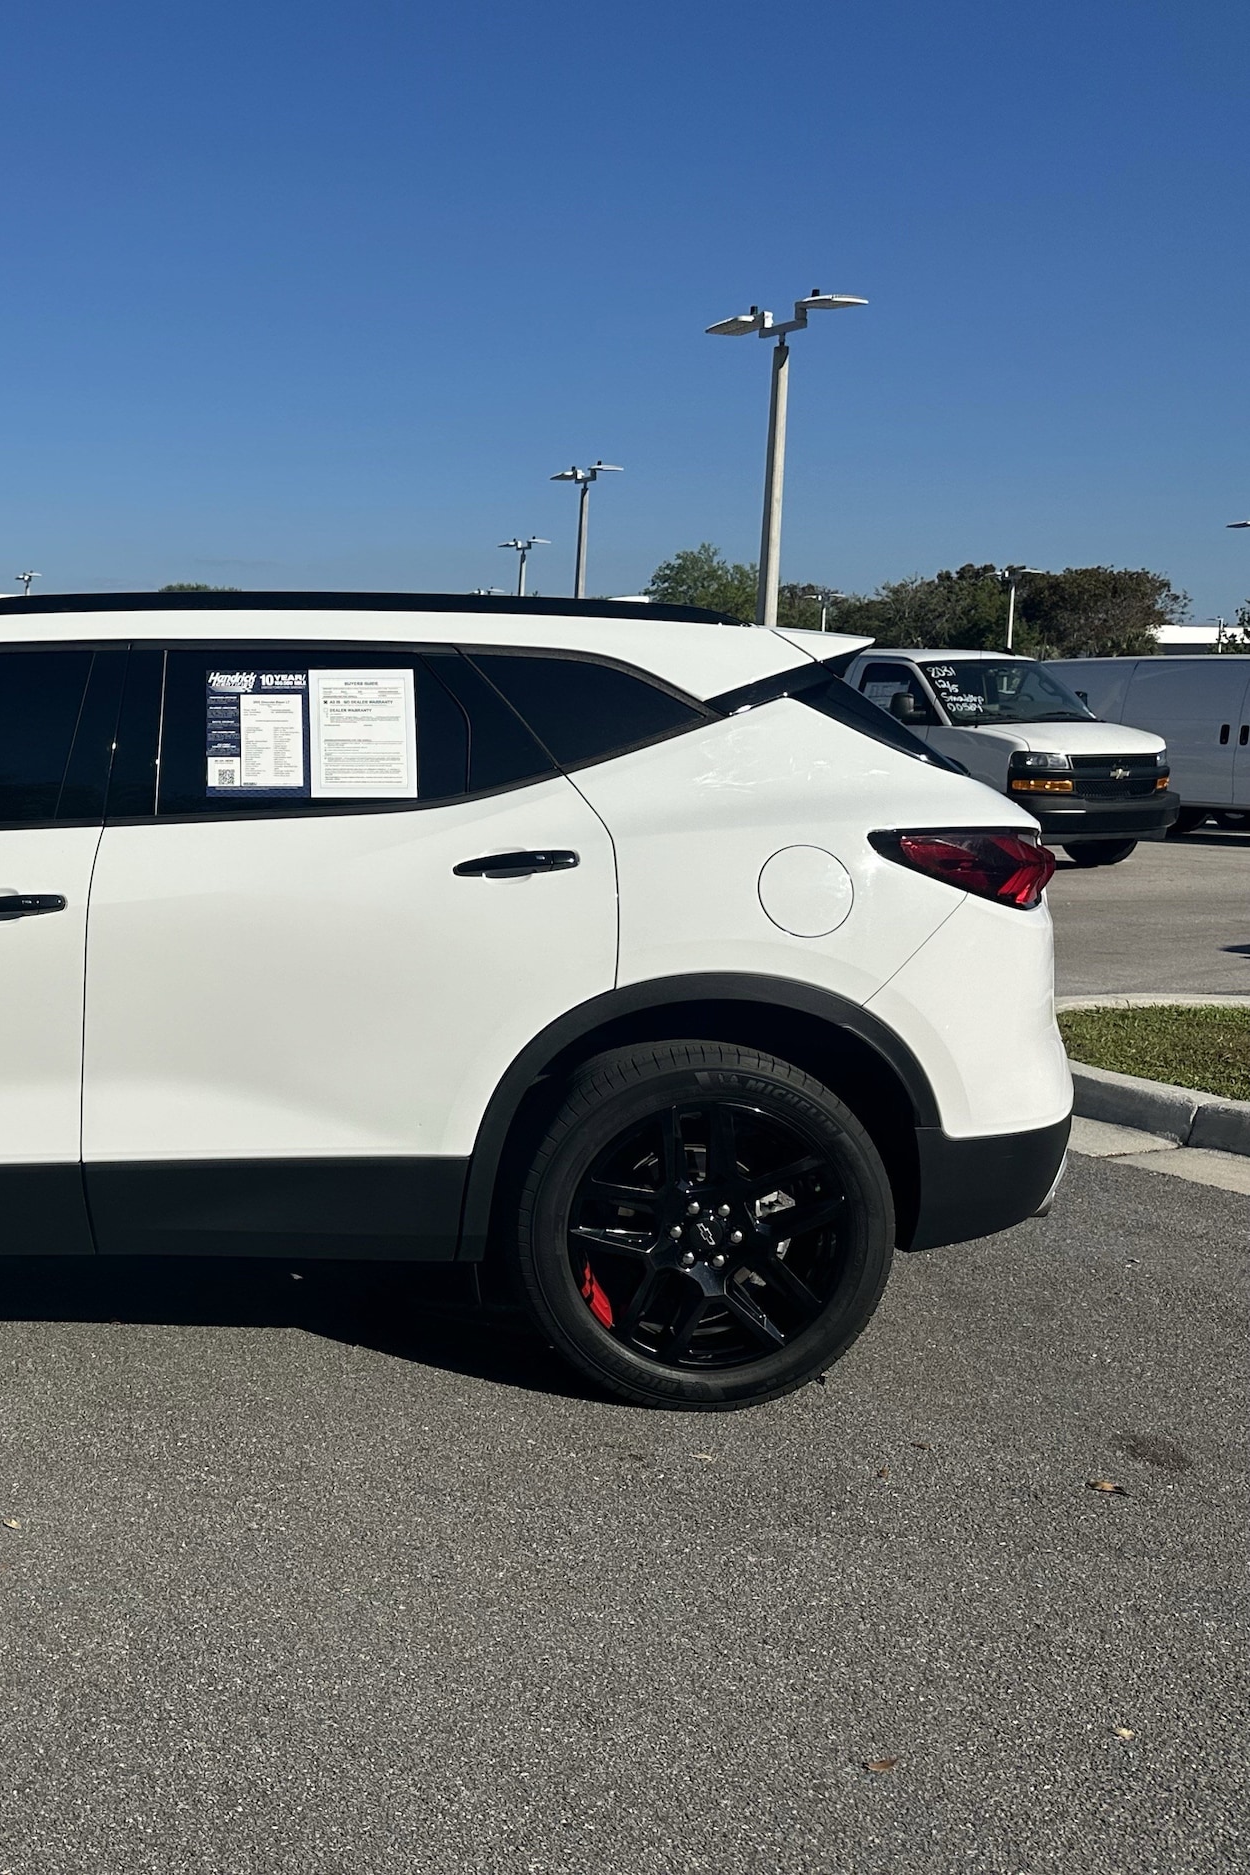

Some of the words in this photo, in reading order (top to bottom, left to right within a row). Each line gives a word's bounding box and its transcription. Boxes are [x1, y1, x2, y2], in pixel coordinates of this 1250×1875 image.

[208, 672, 257, 684] Hendrick
[260, 674, 274, 686] 10
[745, 1078, 839, 1137] MICHELIN
